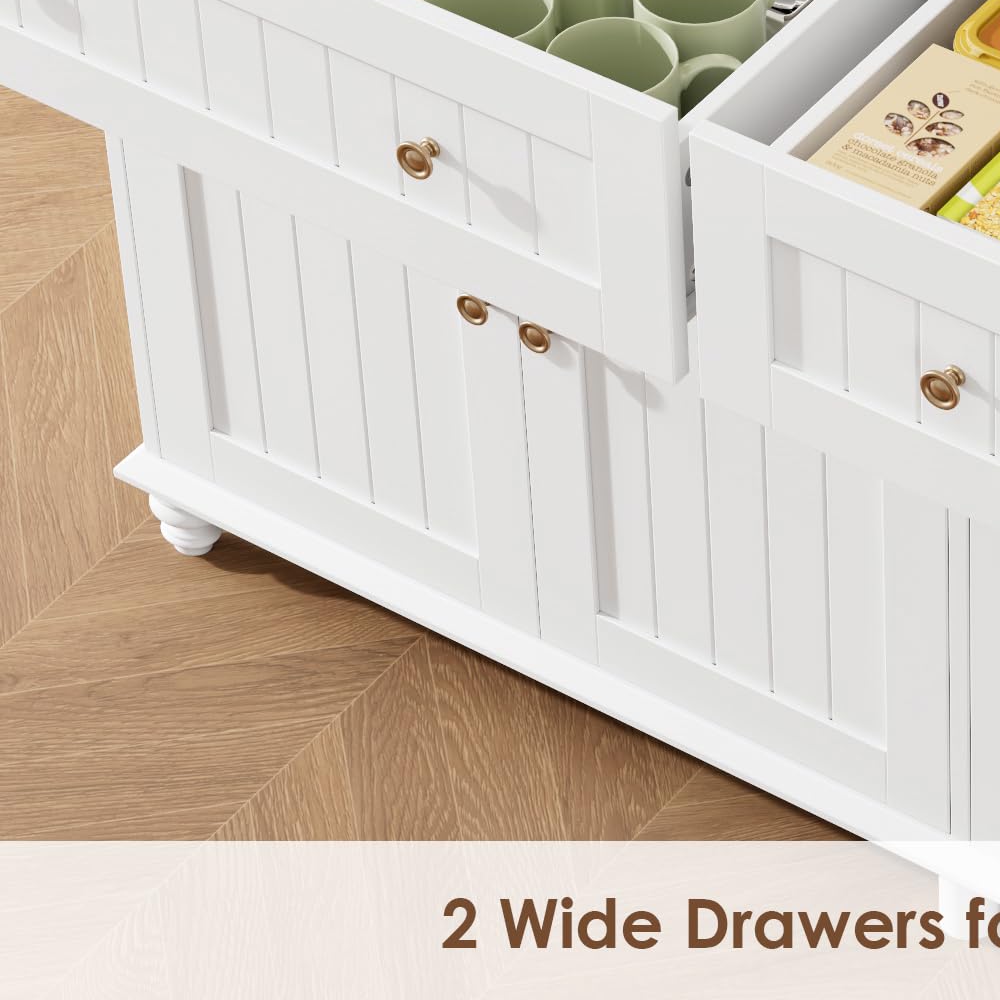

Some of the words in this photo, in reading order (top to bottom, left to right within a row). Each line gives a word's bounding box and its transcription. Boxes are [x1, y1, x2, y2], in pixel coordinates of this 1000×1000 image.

[847, 137, 898, 161] chocolate
[896, 159, 938, 180] granola
[853, 147, 911, 179] macadamia
[911, 172, 937, 187] nuts
